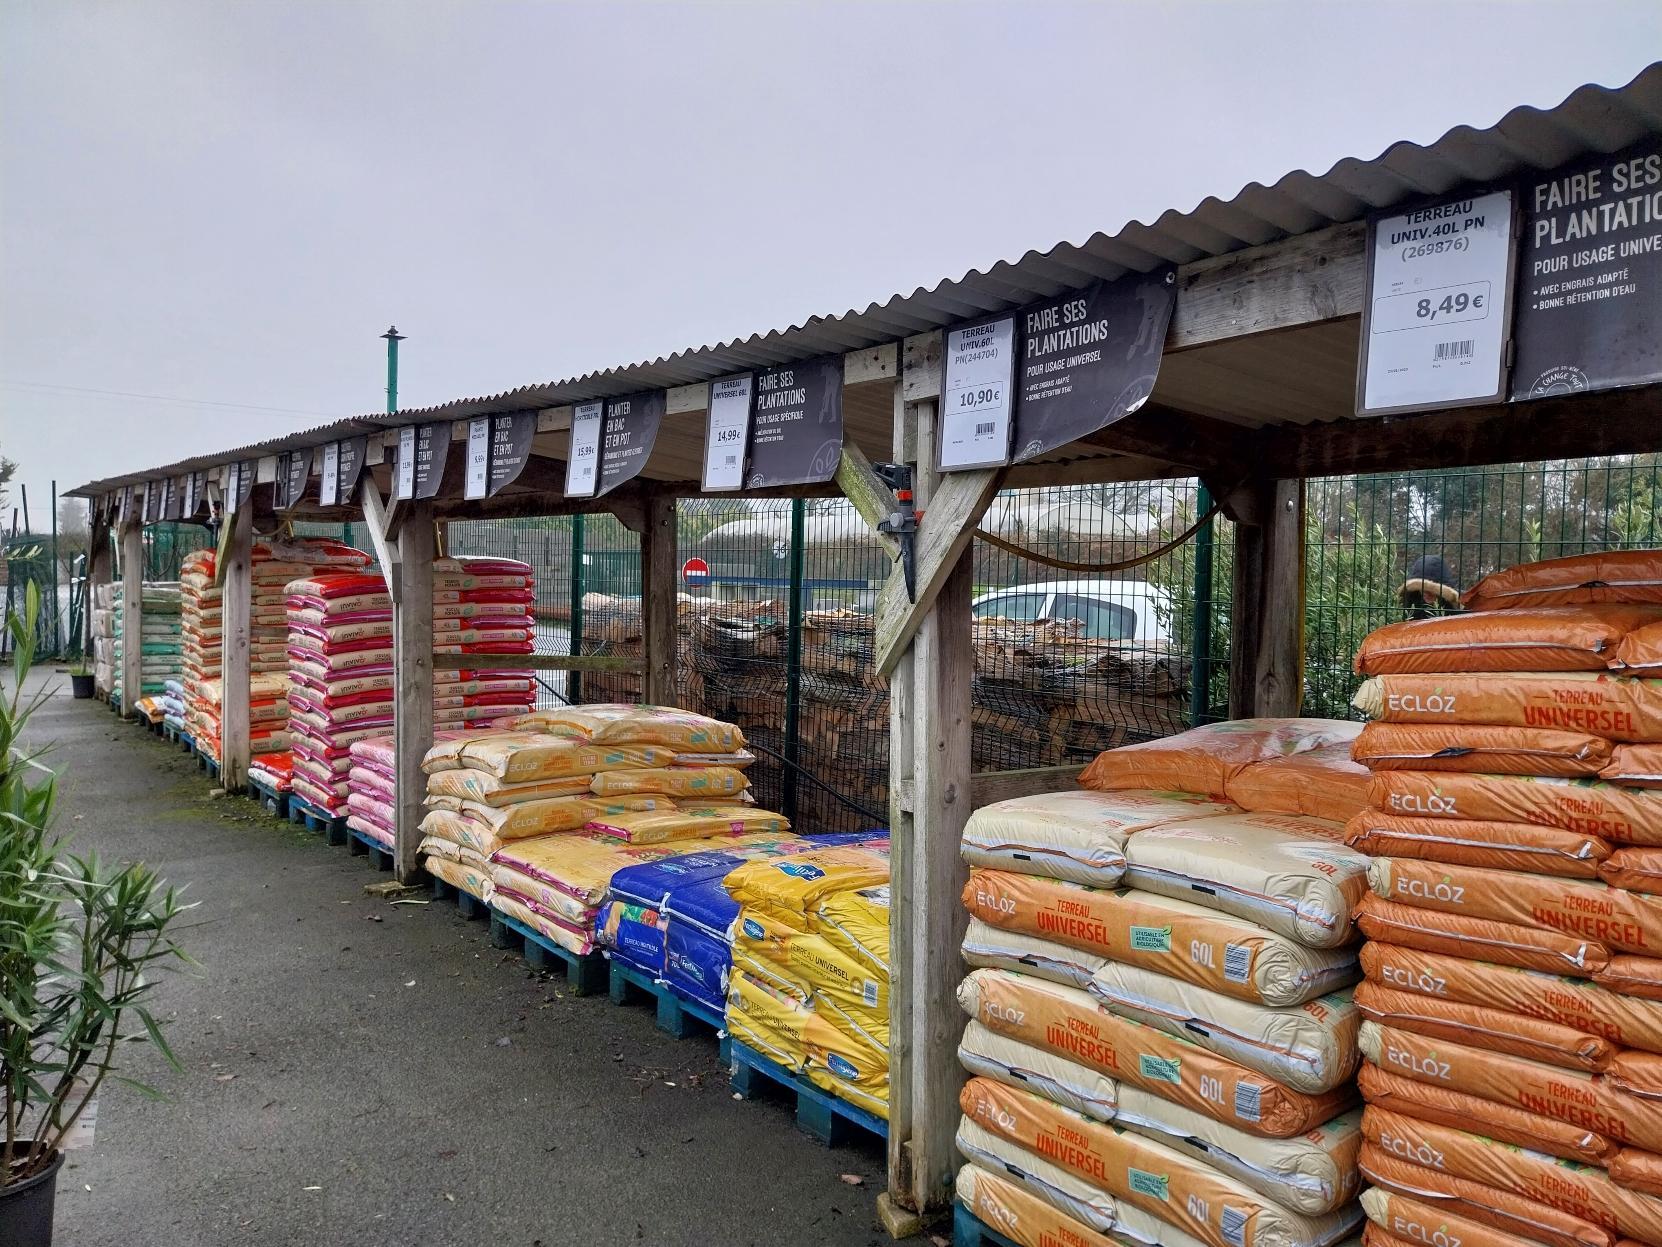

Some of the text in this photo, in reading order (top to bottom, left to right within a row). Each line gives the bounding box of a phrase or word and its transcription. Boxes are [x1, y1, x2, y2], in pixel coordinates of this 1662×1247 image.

[1535, 154, 1661, 214] FAIRE SES
[1404, 200, 1474, 226] TERREAU
[1391, 215, 1486, 246] UNIV.40L PN
[1401, 236, 1470, 263] (269876)
[1534, 255, 1568, 277] POUR
[1572, 245, 1616, 269] USAGE
[1540, 268, 1629, 296] AVEC ENGRAIS ADAPTÉ
[1539, 283, 1636, 312] BONNE RÉTENTION D'EAU
[1027, 299, 1088, 335] FAIRE SES
[960, 337, 995, 352] UNIV.60L
[961, 324, 995, 340] TERREAU
[1027, 319, 1109, 359] PLANTATIONS
[1026, 349, 1102, 378] POUR USAGE UNIVERSEL
[758, 370, 794, 392] FAIRE SES
[607, 401, 631, 418] PLANTER
[757, 387, 806, 410] PLANTATIONS
[615, 418, 625, 432] BAC
[1552, 689, 1603, 707] TERREAU
[1523, 705, 1638, 734] UNIVERSEL
[1552, 796, 1604, 816] TERREAU
[1057, 899, 1090, 918] TERREAU
[1562, 895, 1614, 917] TERREAU
[1037, 911, 1111, 946] UNIVERSEL
[1532, 907, 1649, 948] UNIVERSEL
[790, 942, 815, 961] TERREAU
[815, 956, 850, 981] UNIVERSEL
[1190, 939, 1216, 970] 60L
[1303, 1001, 1330, 1024] 60L
[1543, 989, 1594, 1014] TERREAU
[1067, 1015, 1100, 1040] TERREAU
[1047, 1026, 1120, 1070] UNIVERSEL
[1199, 1074, 1226, 1105] 60L
[1547, 1081, 1597, 1108] TERREAU
[1056, 1124, 1089, 1150] TERREAU
[1036, 1132, 1109, 1182] UNIVERSEL
[1540, 1174, 1589, 1202] TERREAU
